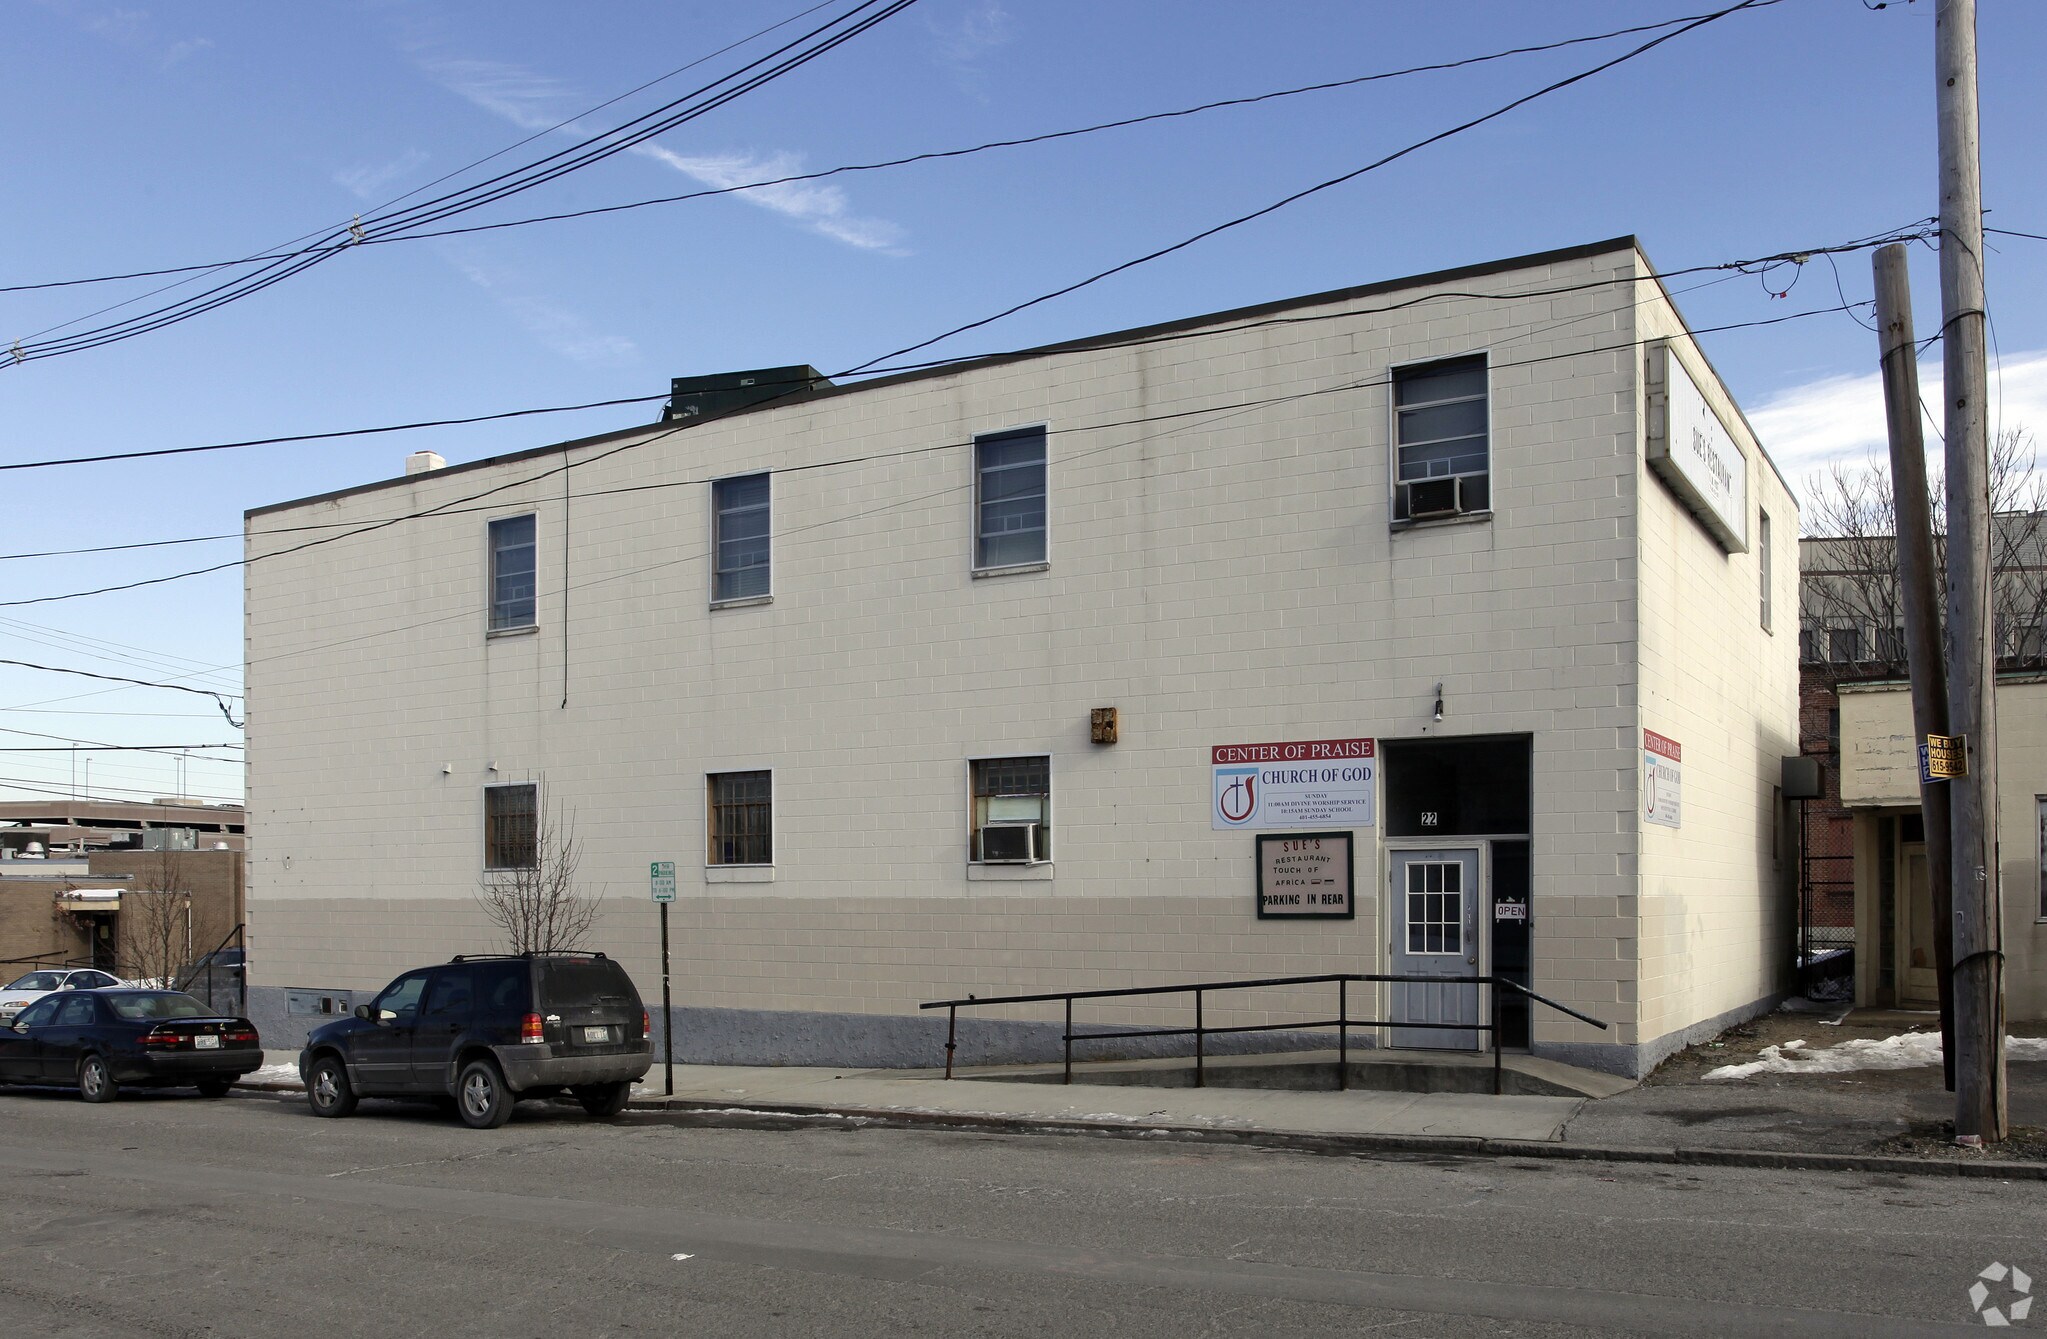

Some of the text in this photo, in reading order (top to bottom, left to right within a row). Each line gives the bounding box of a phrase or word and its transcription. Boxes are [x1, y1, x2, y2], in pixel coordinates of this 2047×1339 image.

[1930, 738, 1962, 749] WE BUY
[1216, 742, 1371, 762] CENTER OF PRAISE
[1930, 747, 1964, 759] HOUSES
[1262, 767, 1372, 785] CHURCH OF GOD
[1422, 813, 1437, 825] 22
[1283, 839, 1321, 852] SUE'S
[1275, 854, 1331, 865] RESTAURANT
[652, 865, 658, 876] 2
[1273, 866, 1301, 874] TOUCH
[1263, 893, 1344, 906] PARKING IN REAR
[1498, 906, 1525, 916] OPEN
